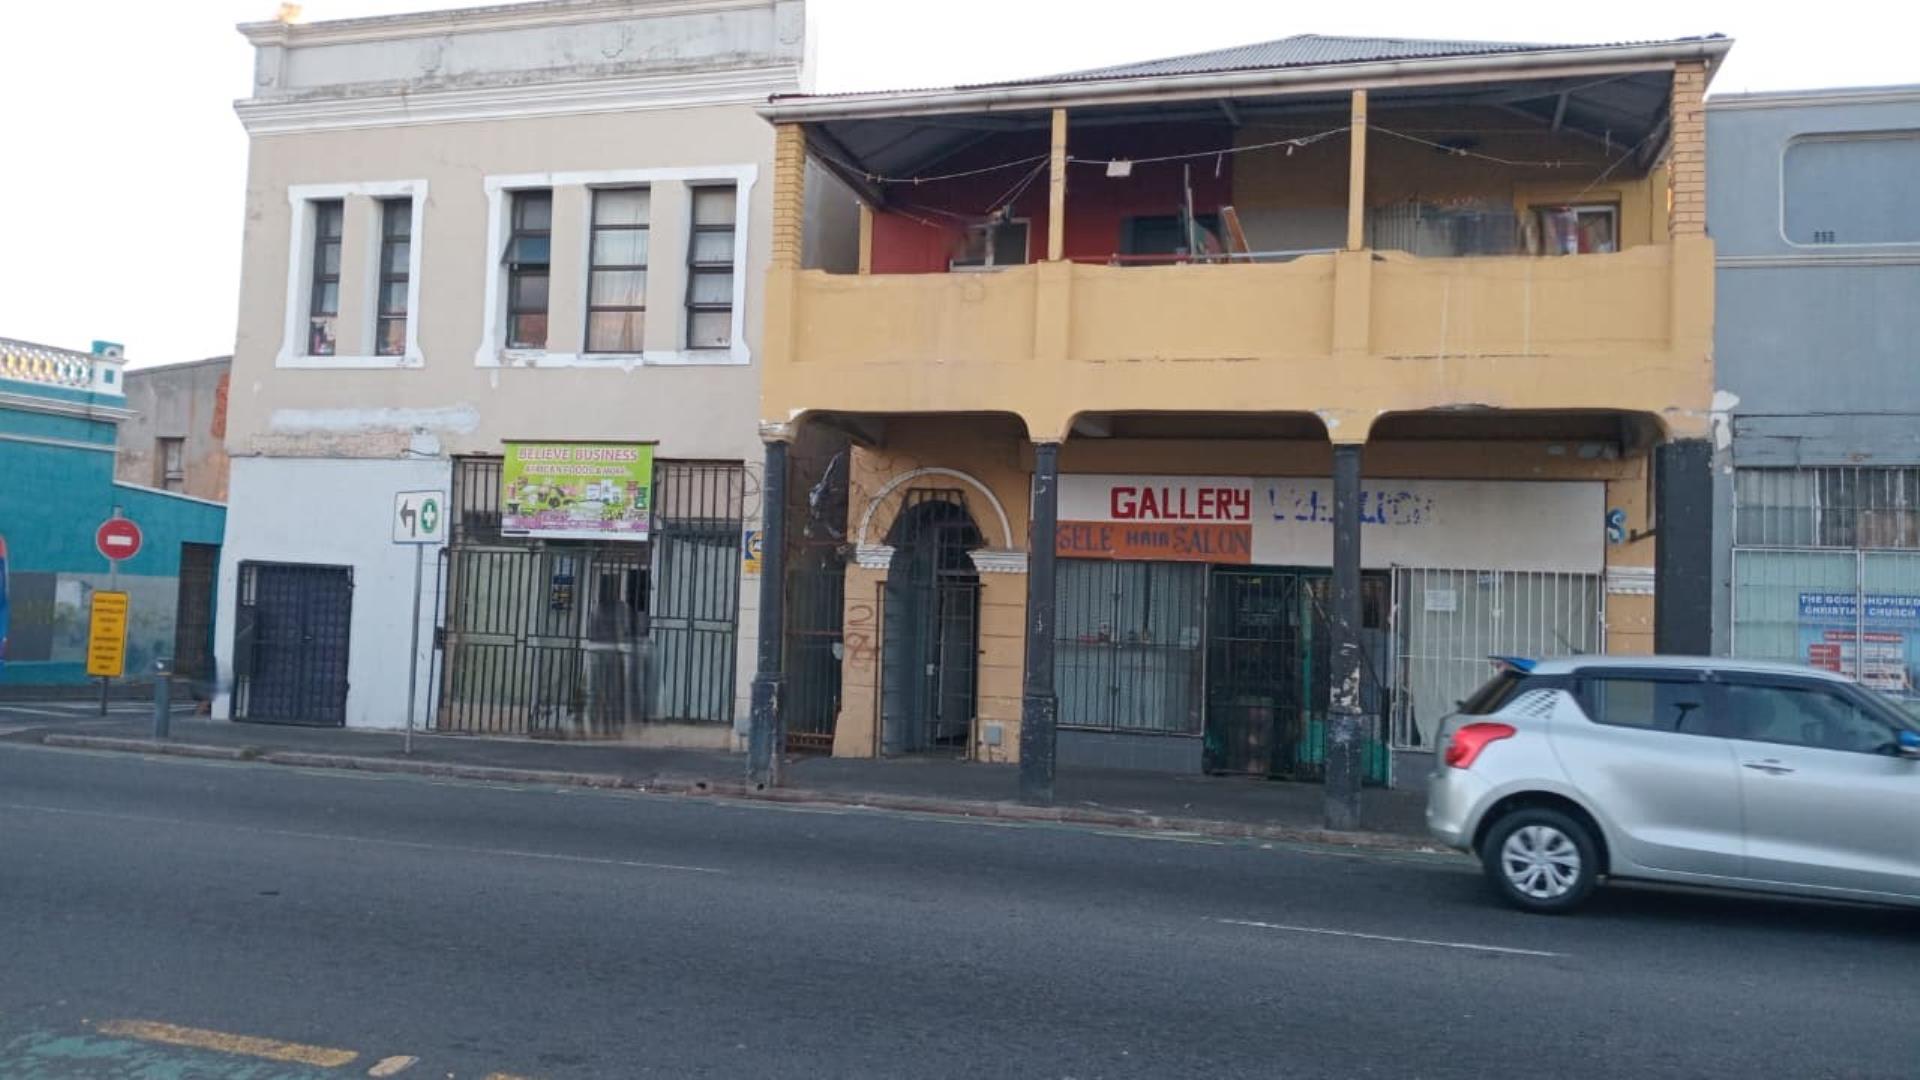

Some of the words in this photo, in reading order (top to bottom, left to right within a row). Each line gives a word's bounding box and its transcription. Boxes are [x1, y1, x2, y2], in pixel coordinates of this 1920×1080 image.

[518, 447, 569, 460] BELIEVE
[575, 448, 638, 461] BUSINESS
[1110, 486, 1250, 520] GALLERY
[1125, 530, 1170, 548] HAIR
[1173, 525, 1250, 554] SALON
[1801, 595, 1823, 604] THE
[1805, 606, 1863, 616] CHRISTIA
[1869, 608, 1916, 617] CHURCH
